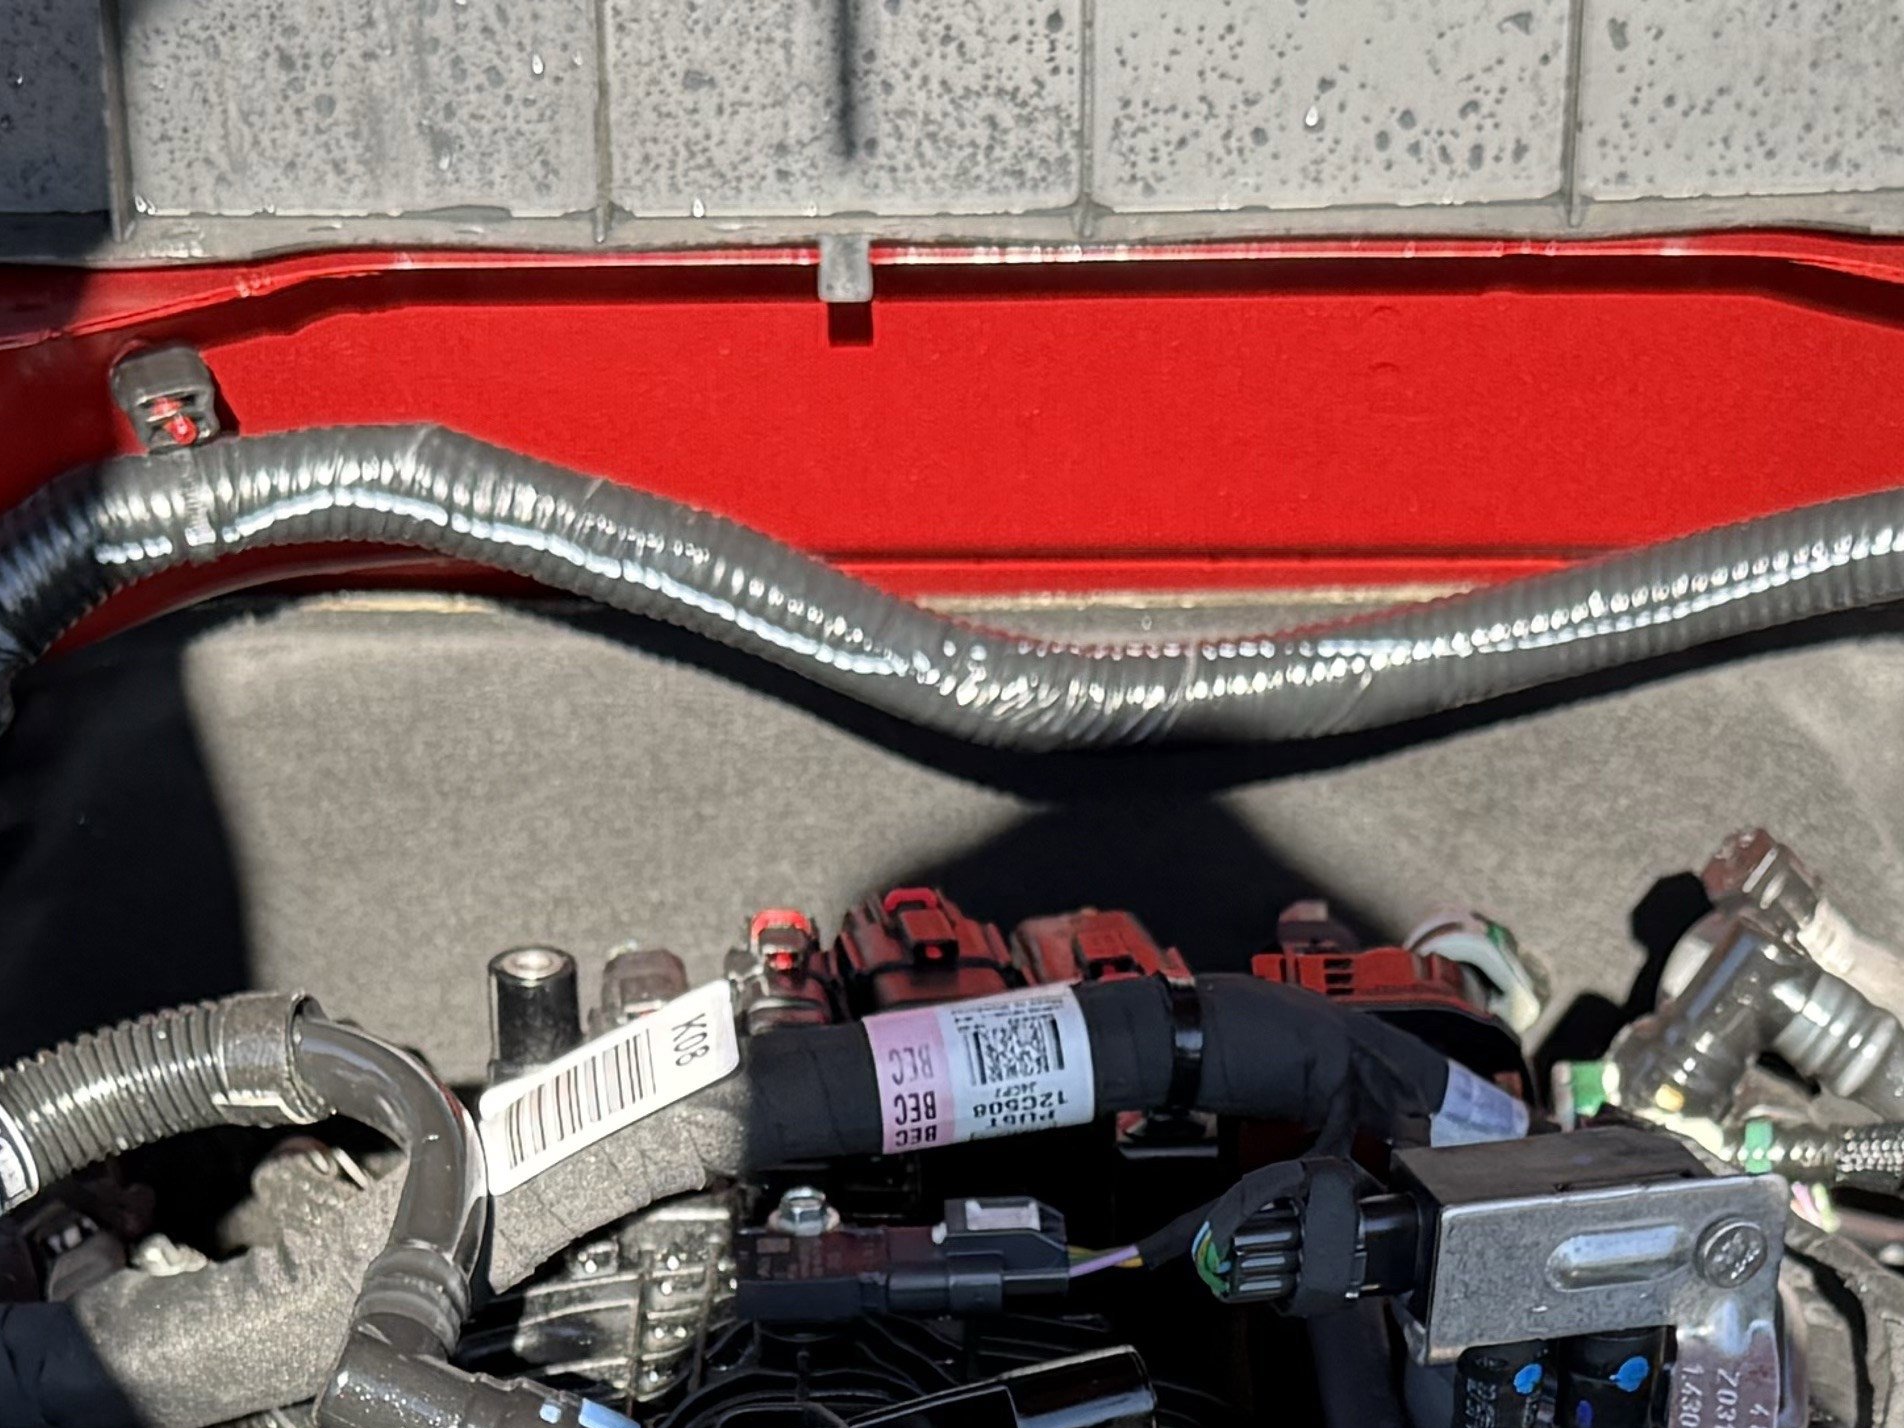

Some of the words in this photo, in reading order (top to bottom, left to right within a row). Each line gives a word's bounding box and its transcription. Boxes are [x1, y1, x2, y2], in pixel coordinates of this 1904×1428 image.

[671, 1012, 711, 1067] K08
[889, 1043, 934, 1086] BEC
[893, 1090, 938, 1125] BEC
[971, 1090, 1069, 1119] 12C508
[894, 1124, 938, 1148] BEC
